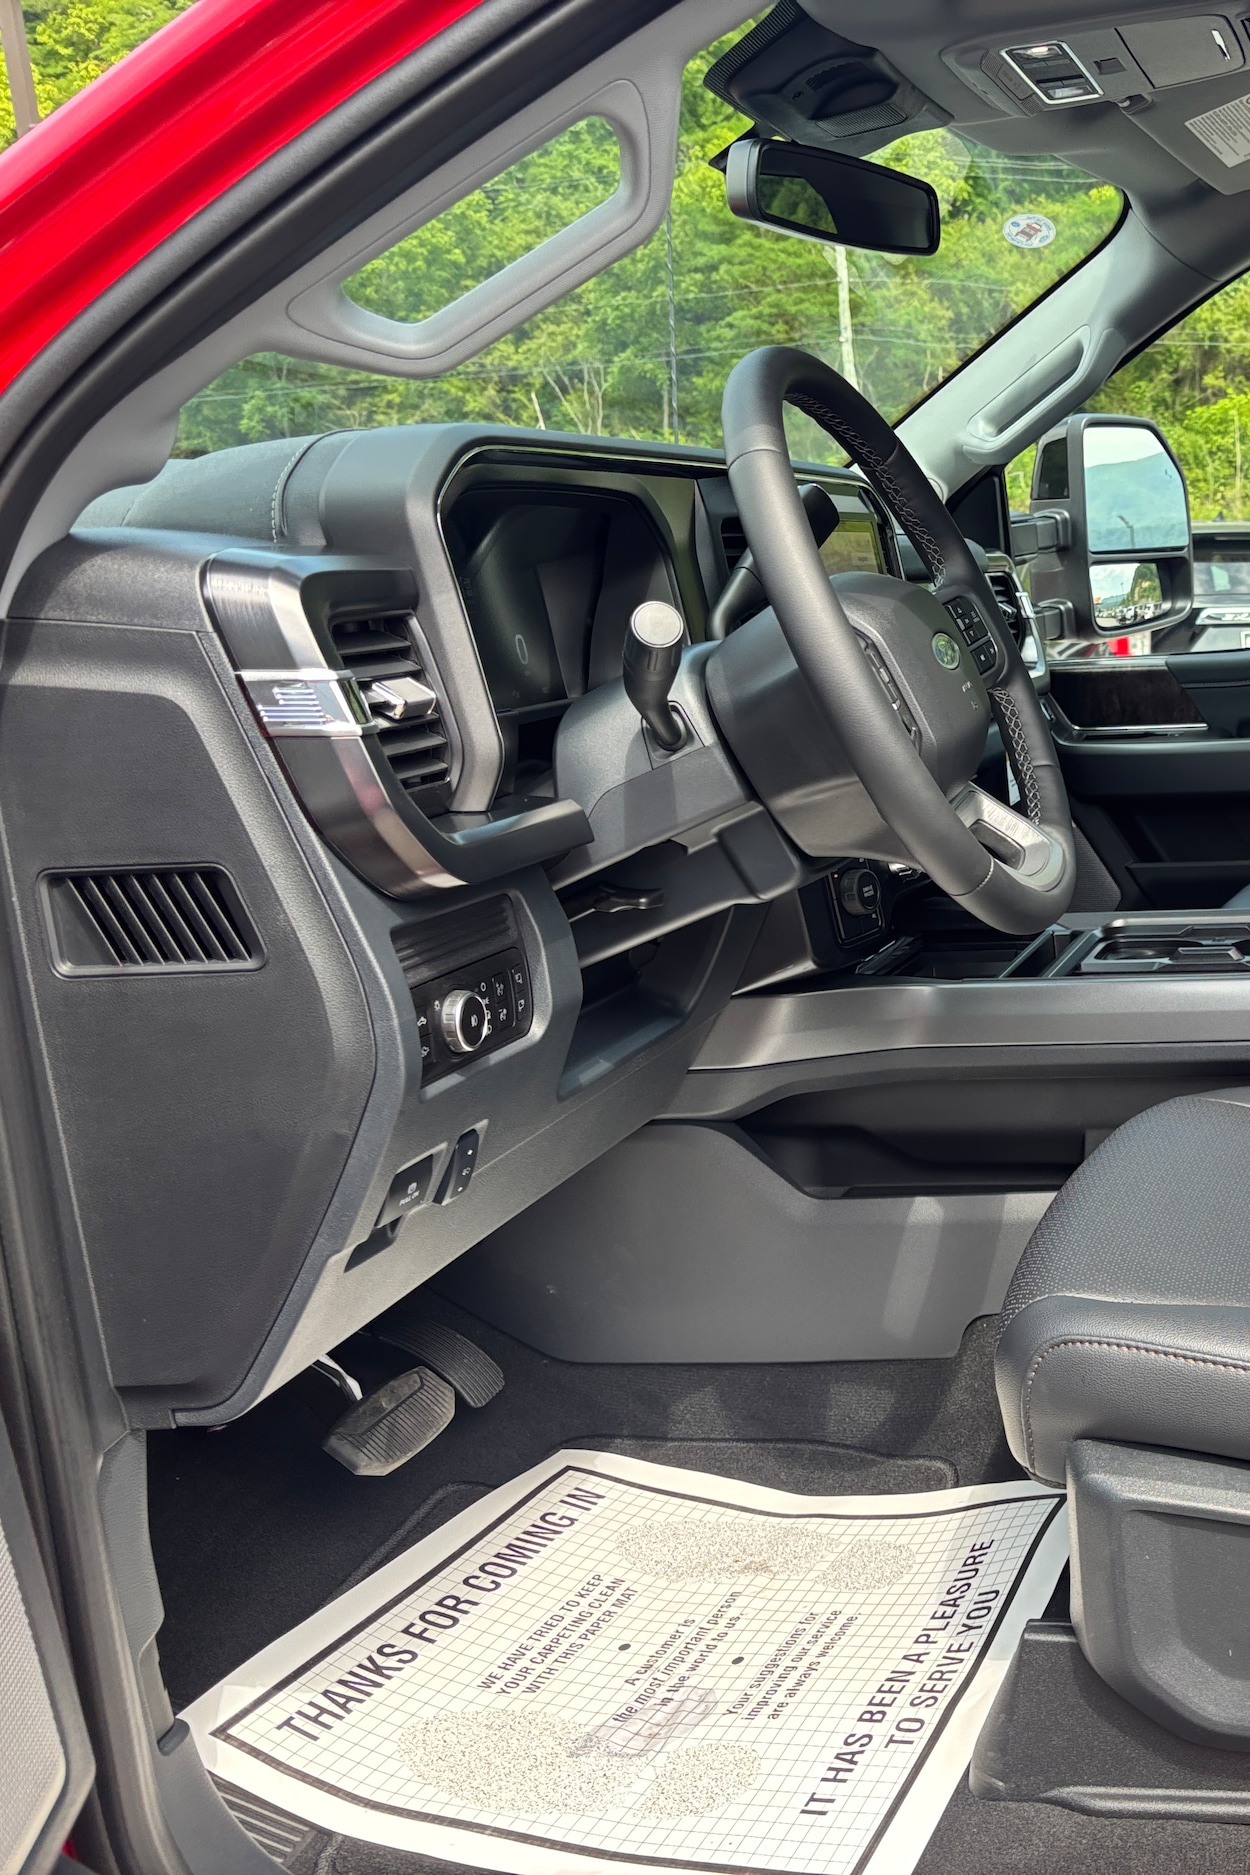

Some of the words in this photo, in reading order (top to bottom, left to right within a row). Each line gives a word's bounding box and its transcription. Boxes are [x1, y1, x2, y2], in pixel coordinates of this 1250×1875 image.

[276, 1644, 418, 1741] THANKS
[400, 1595, 480, 1644] FOR
[463, 1512, 579, 1592] COMING
[559, 1487, 606, 1511] IN
[477, 1672, 504, 1689] WE
[498, 1643, 534, 1671] HAVE
[527, 1614, 565, 1642] TRIED
[559, 1600, 580, 1612] TO
[575, 1574, 604, 1598] KEEP
[496, 1666, 536, 1695] YOUR
[530, 1611, 594, 1664] CARPETING
[588, 1578, 626, 1609] CLEAN
[522, 1667, 559, 1694] WITH
[553, 1642, 584, 1664] THIS
[578, 1610, 618, 1640] PAPER
[611, 1586, 638, 1609] MAT
[913, 1538, 995, 1645] PLEASURE
[612, 1705, 638, 1722] the
[634, 1677, 666, 1705] most
[657, 1626, 711, 1676] important
[706, 1591, 742, 1625] person
[624, 1677, 641, 1686] A
[636, 1628, 684, 1675] customer
[678, 1619, 695, 1628] is
[666, 1675, 690, 1693] the
[686, 1643, 718, 1672] world
[711, 1632, 728, 1642] to
[722, 1692, 753, 1715] Your
[749, 1628, 806, 1688] suggestions
[798, 1612, 819, 1625] for
[741, 1665, 798, 1720] improving
[791, 1647, 811, 1663] our
[807, 1610, 841, 1645] service
[767, 1702, 789, 1720] are
[784, 1661, 821, 1698] always
[815, 1612, 862, 1658] welcome.
[857, 1669, 917, 1723] BEEN
[884, 1717, 926, 1748] TO
[909, 1641, 975, 1707] SERVE
[957, 1589, 1000, 1638] YOU
[901, 1651, 930, 1664] A
[800, 1792, 836, 1816] IT
[820, 1733, 874, 1783] HAS
